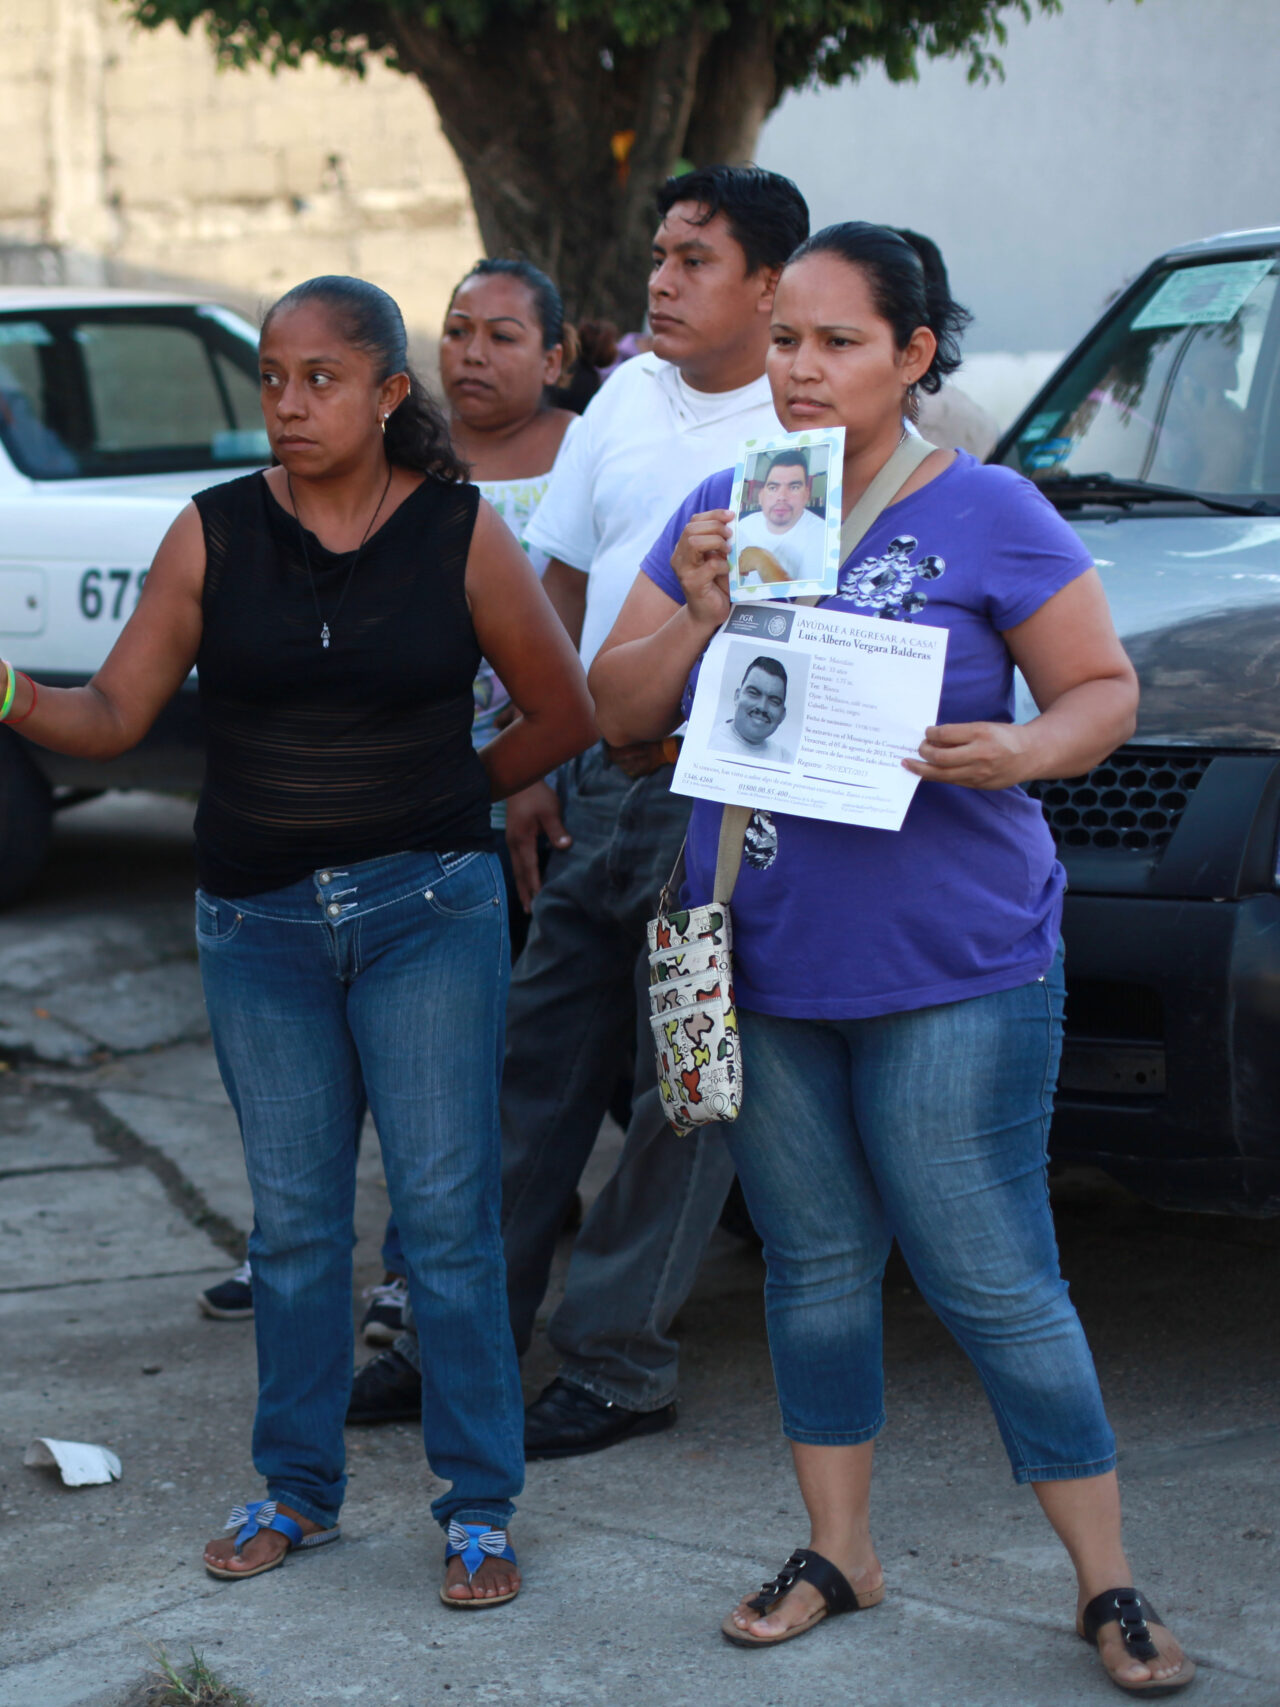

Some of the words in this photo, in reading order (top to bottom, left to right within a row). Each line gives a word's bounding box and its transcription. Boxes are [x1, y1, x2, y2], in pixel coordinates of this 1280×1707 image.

[798, 629, 817, 641] Luis
[819, 633, 852, 648] Alberto
[853, 638, 888, 654] Vergara
[890, 645, 932, 661] Balderas
[841, 627, 847, 635] A
[849, 628, 897, 643] REGRESAR
